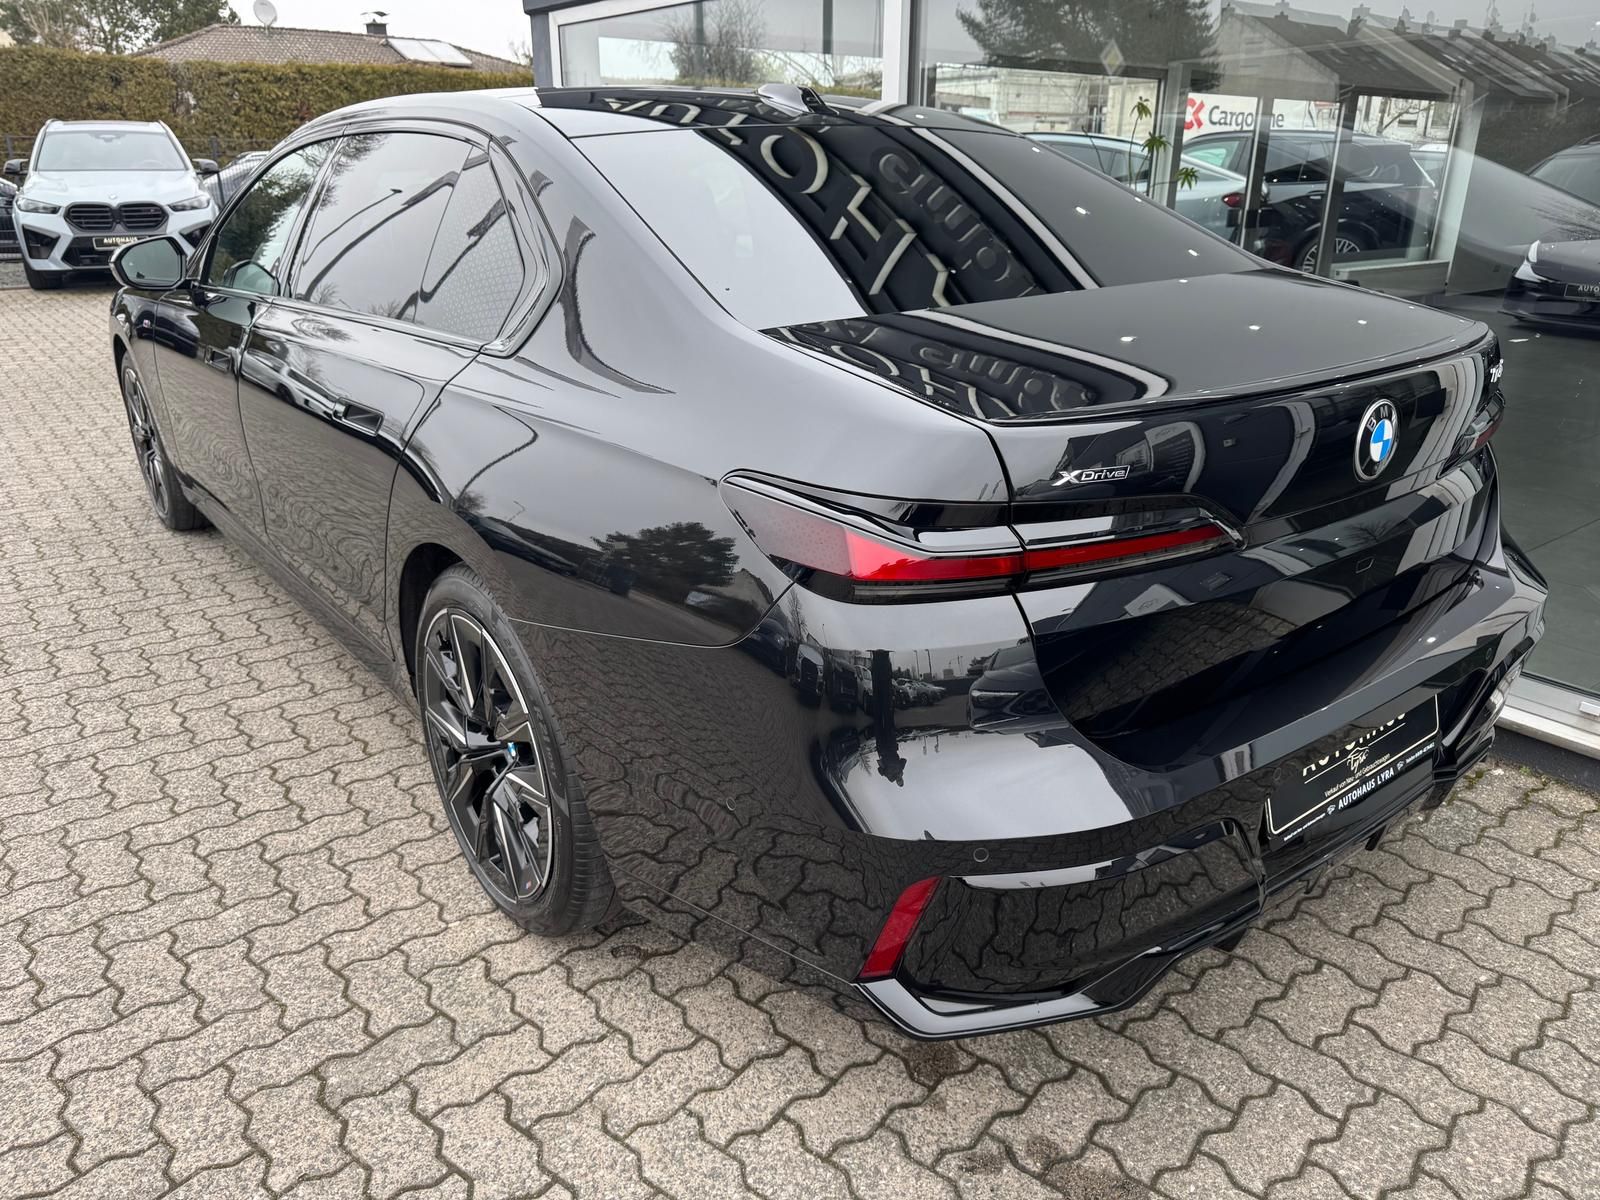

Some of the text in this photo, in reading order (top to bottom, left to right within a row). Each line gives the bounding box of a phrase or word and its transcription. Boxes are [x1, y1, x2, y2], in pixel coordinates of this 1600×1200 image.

[1208, 105, 1285, 130] Cargoe
[103, 236, 138, 244] AUTOHAUS
[1338, 766, 1395, 810] AUTOHAUS LYRA
